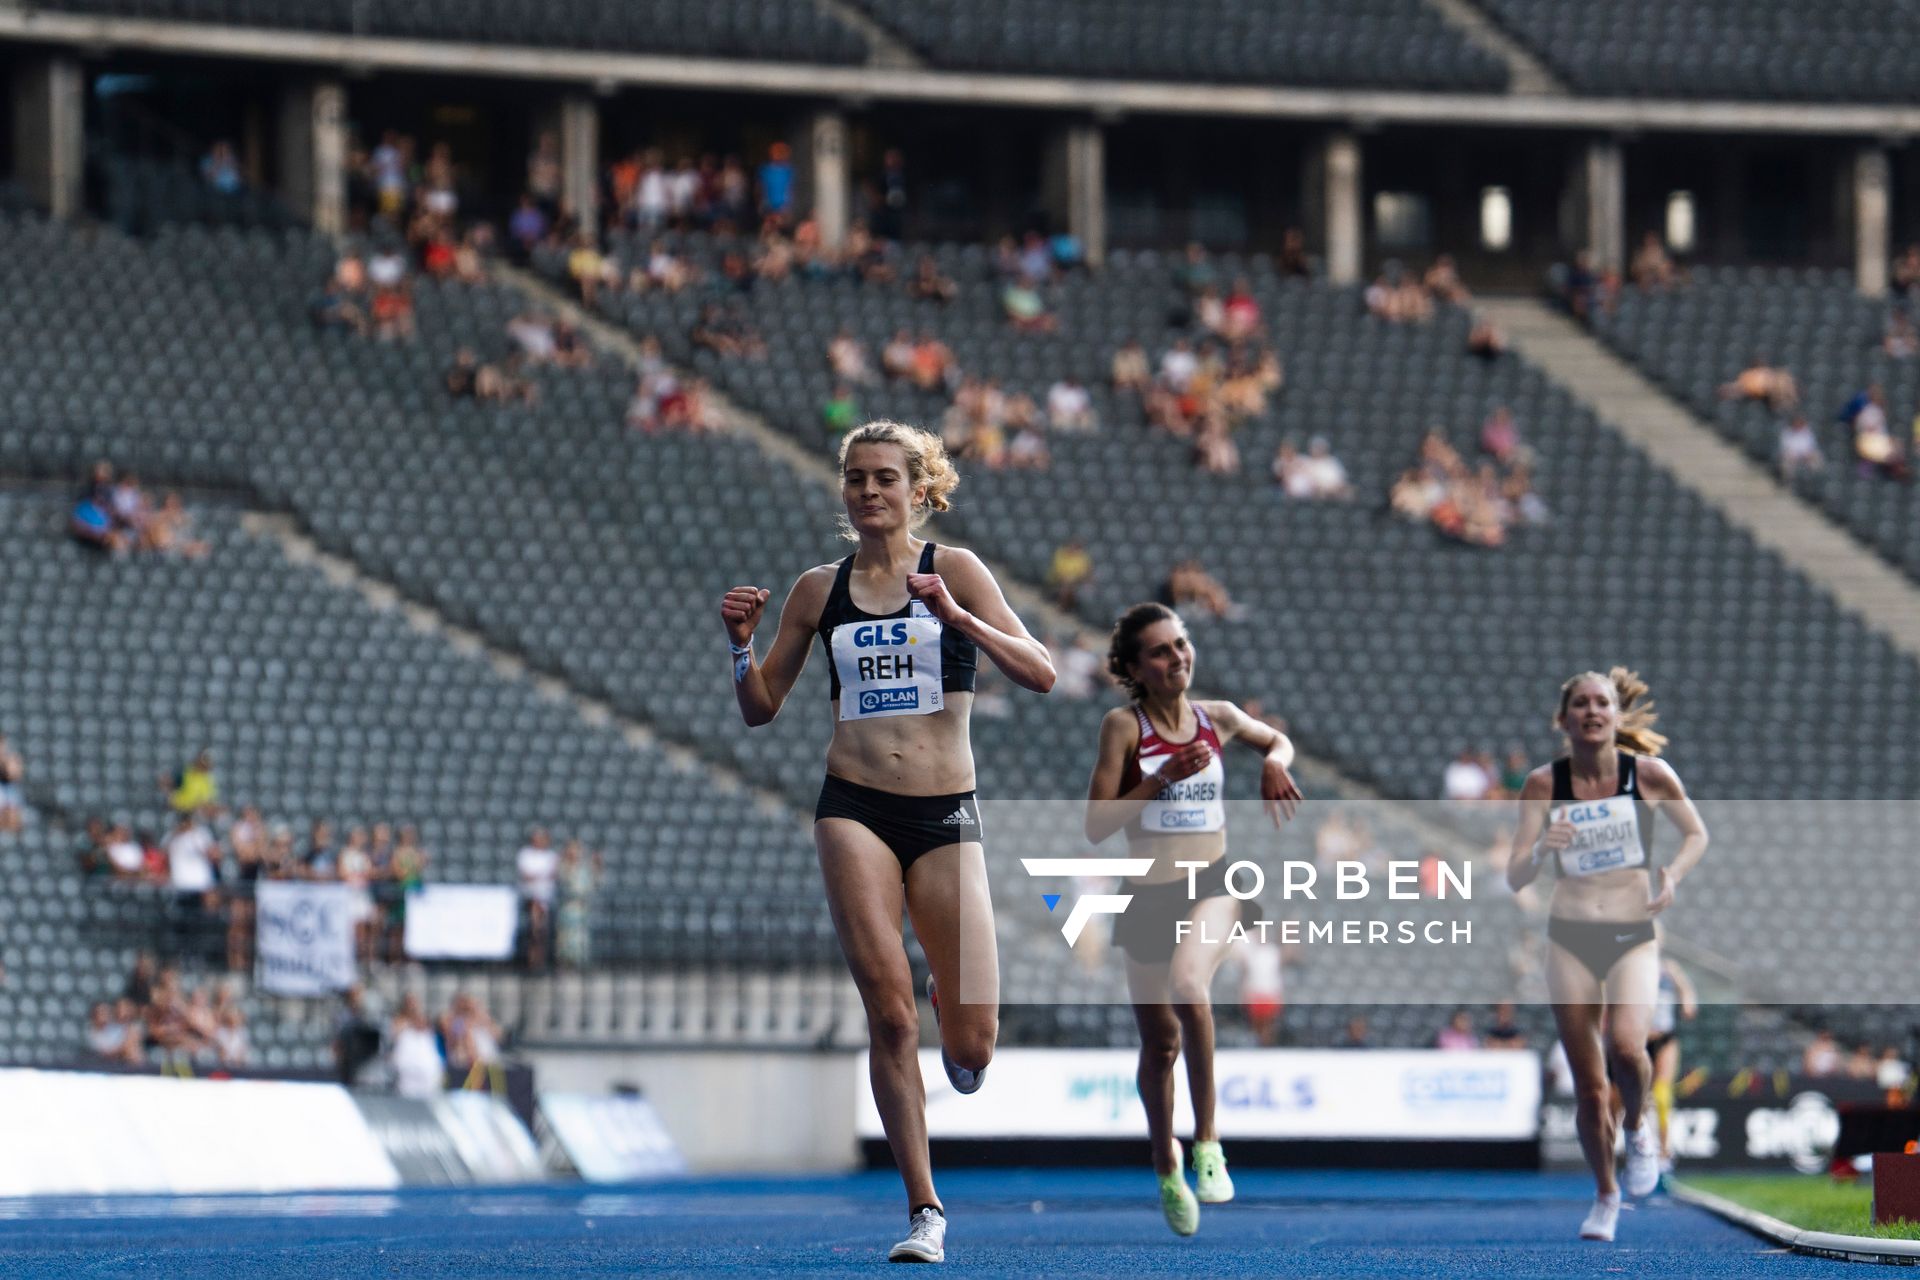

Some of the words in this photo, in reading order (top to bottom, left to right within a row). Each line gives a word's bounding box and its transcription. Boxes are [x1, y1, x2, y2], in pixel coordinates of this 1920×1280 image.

[858, 655, 913, 681] REH
[881, 691, 916, 702] PLAN
[1157, 783, 1216, 802] ENFARES
